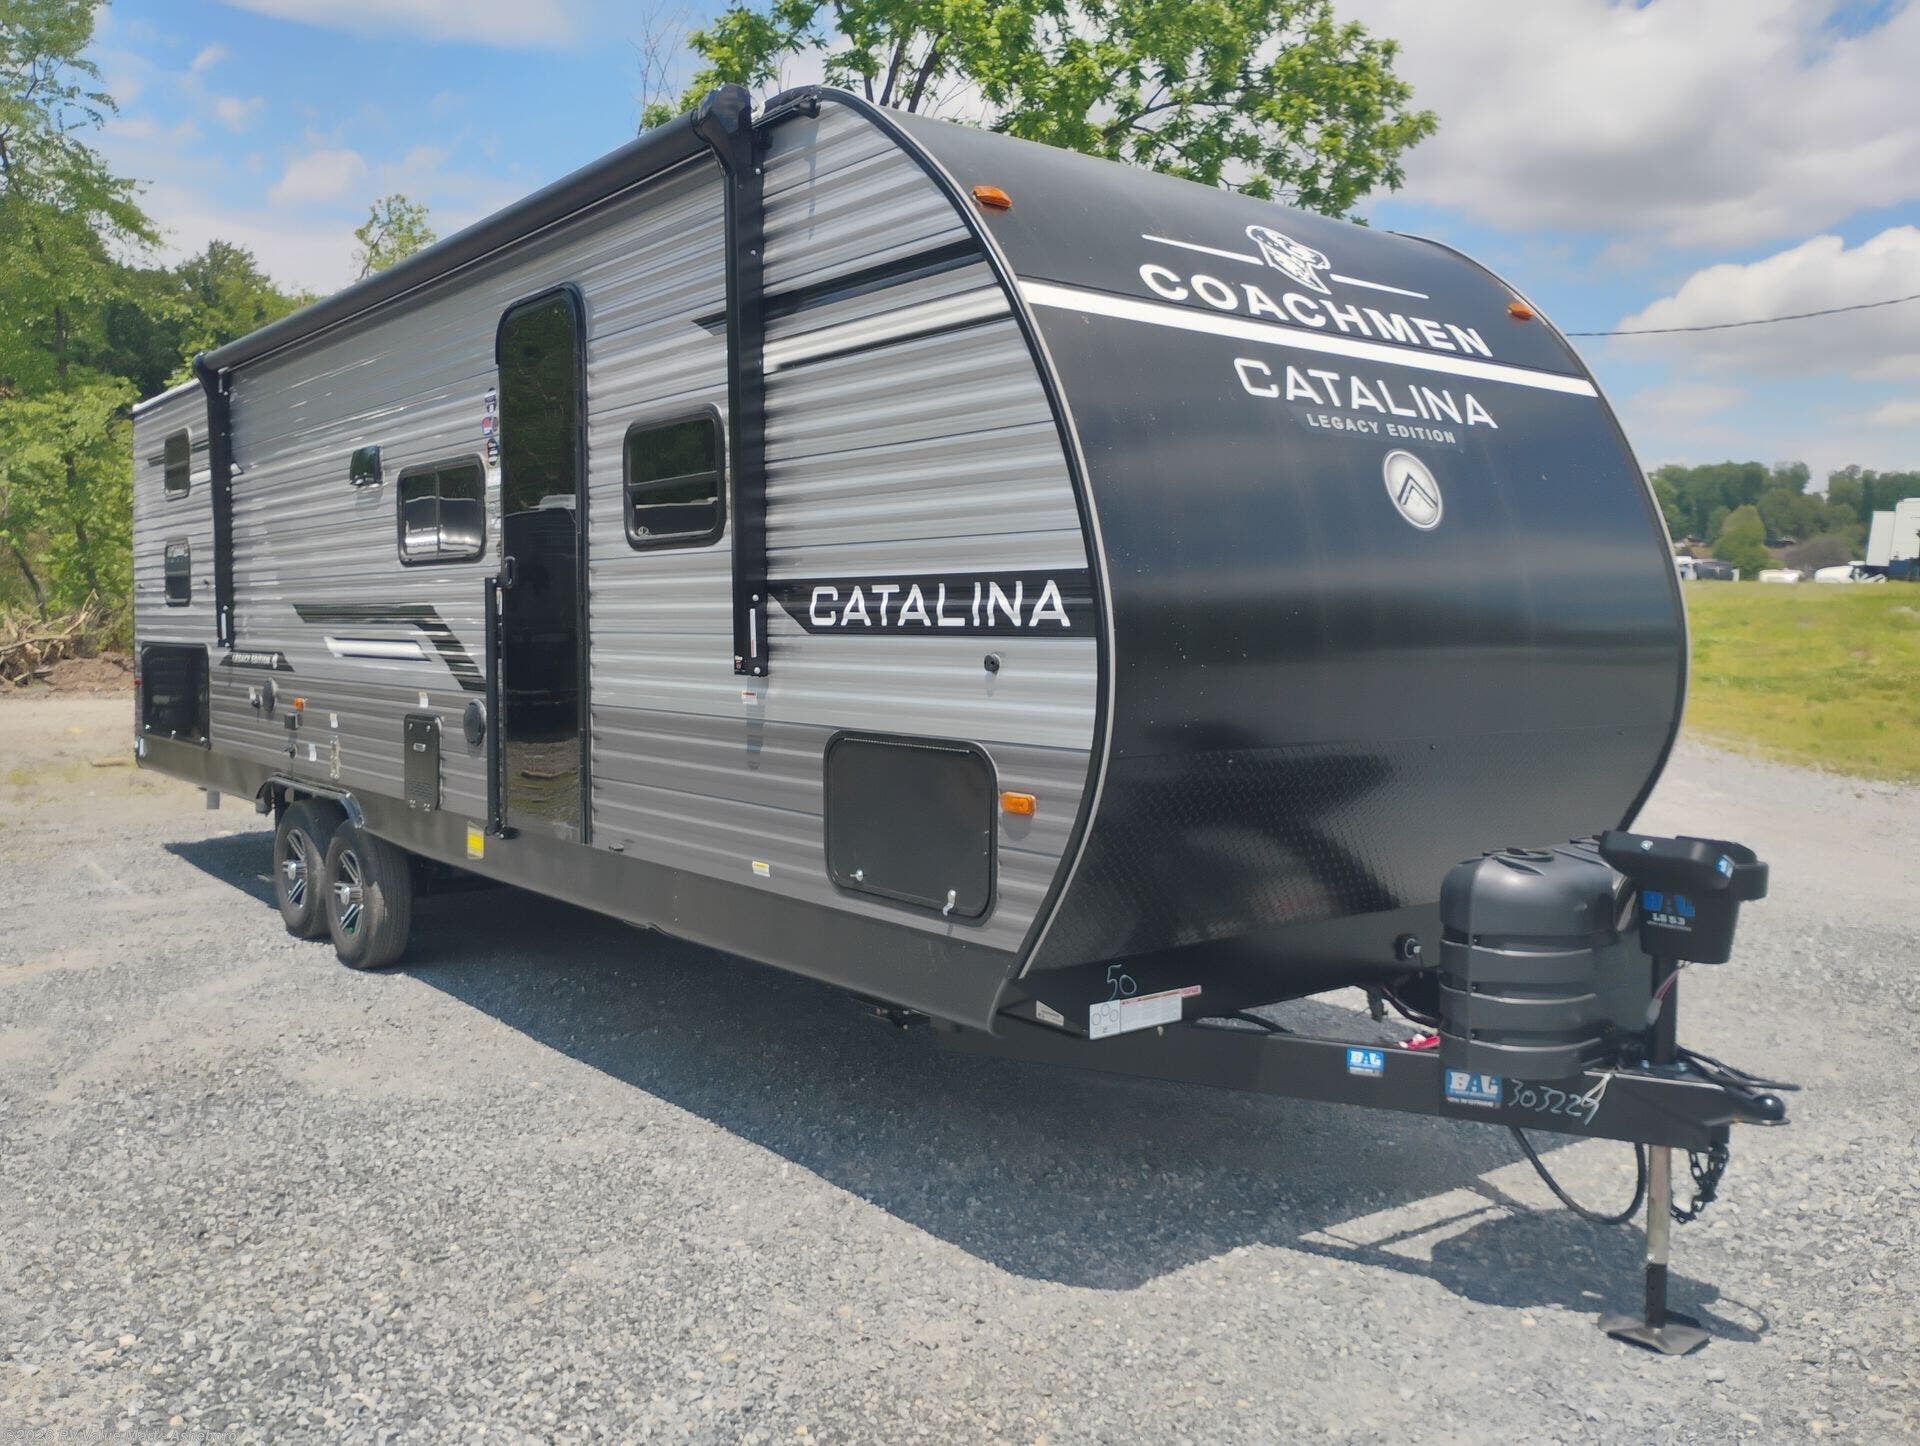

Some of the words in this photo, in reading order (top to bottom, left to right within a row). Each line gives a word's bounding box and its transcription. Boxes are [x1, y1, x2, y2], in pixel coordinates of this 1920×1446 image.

[1138, 263, 1494, 357] COACHMEN
[1233, 357, 1499, 429] CATALINA
[1306, 413, 1380, 435] LEGACY
[1386, 423, 1457, 444] EDITION
[809, 579, 1071, 627] CATALINA
[1106, 964, 1137, 1001] 50
